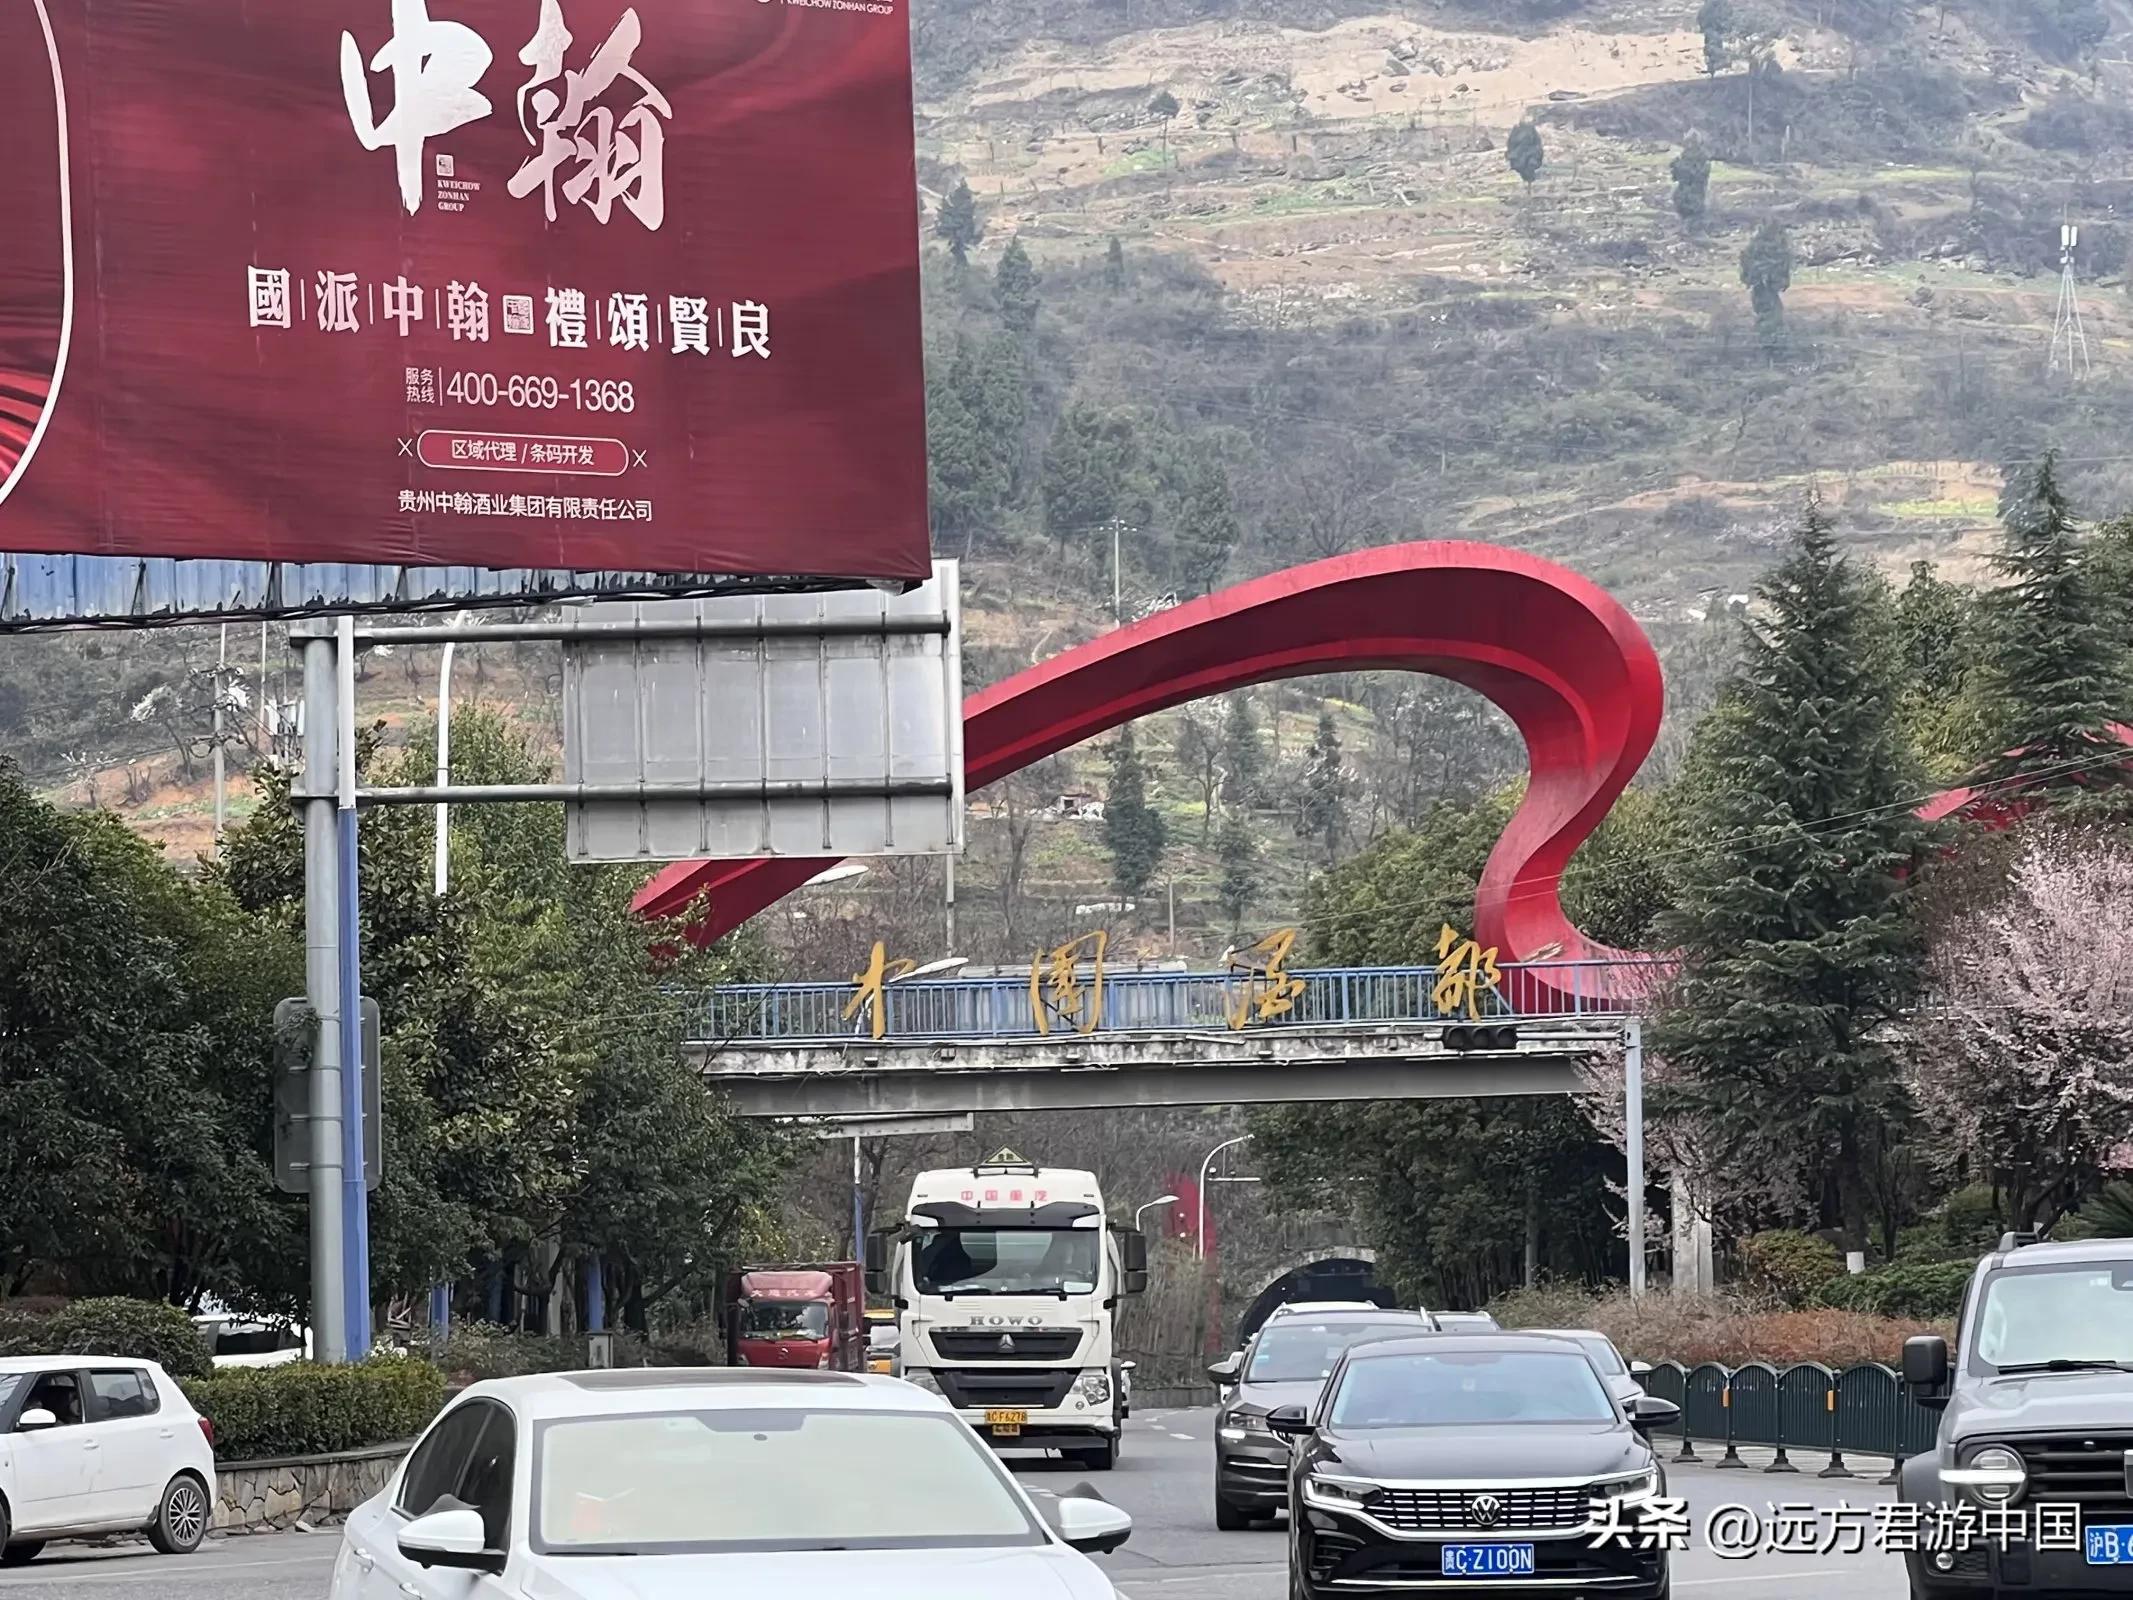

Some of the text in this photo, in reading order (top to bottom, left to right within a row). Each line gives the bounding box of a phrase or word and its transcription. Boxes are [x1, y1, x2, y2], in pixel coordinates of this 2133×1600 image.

[867, 4, 894, 15] GROUP
[437, 201, 465, 212] GROUP
[405, 367, 434, 386] 服务
[405, 385, 435, 404] 热线
[446, 371, 635, 414] 400-669-1368
[398, 489, 653, 522] 贵州中翰酒业集团有限责任公司
[968, 1315, 1043, 1326] HOWO
